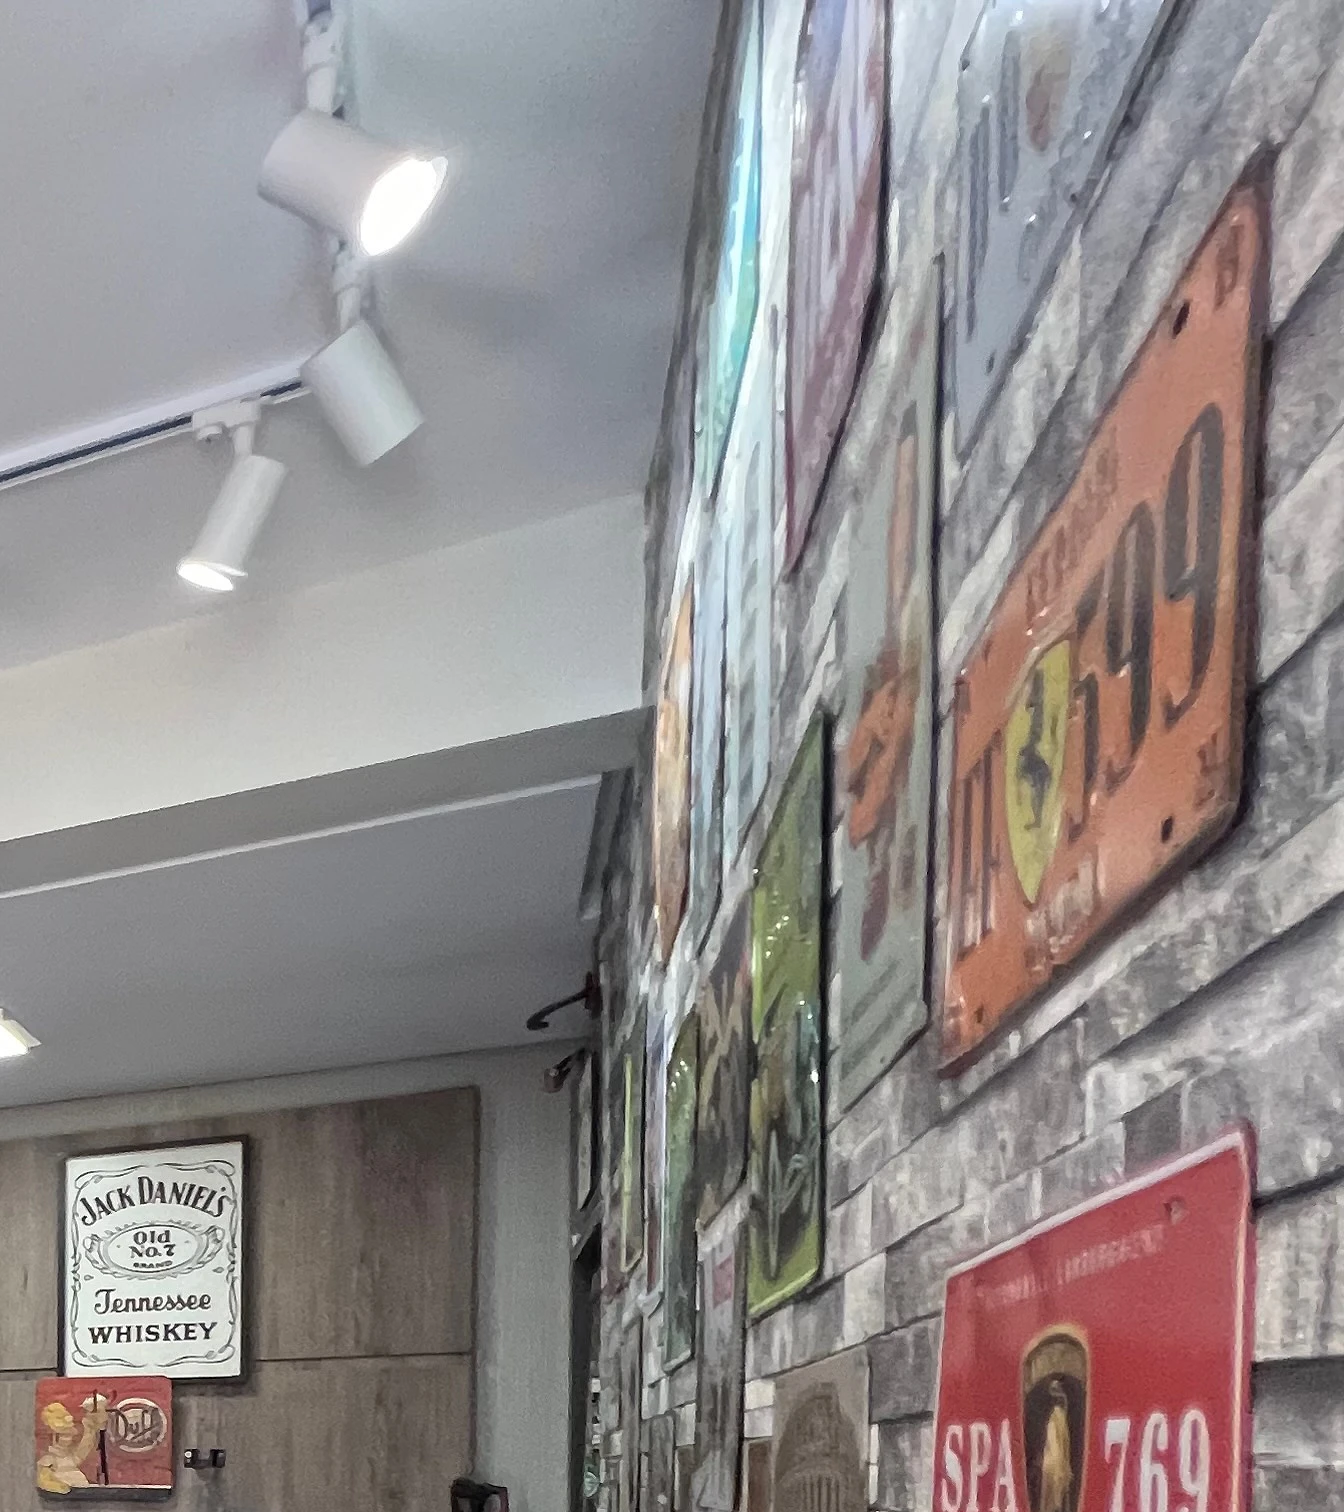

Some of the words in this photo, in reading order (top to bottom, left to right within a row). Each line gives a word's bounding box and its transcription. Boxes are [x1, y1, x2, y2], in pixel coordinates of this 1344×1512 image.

[81, 1184, 137, 1226] JACK
[138, 1175, 231, 1218] DANIEL'S
[133, 1229, 171, 1245] Old
[94, 1287, 212, 1316] Tennessee
[87, 1321, 218, 1345] WHISKEY
